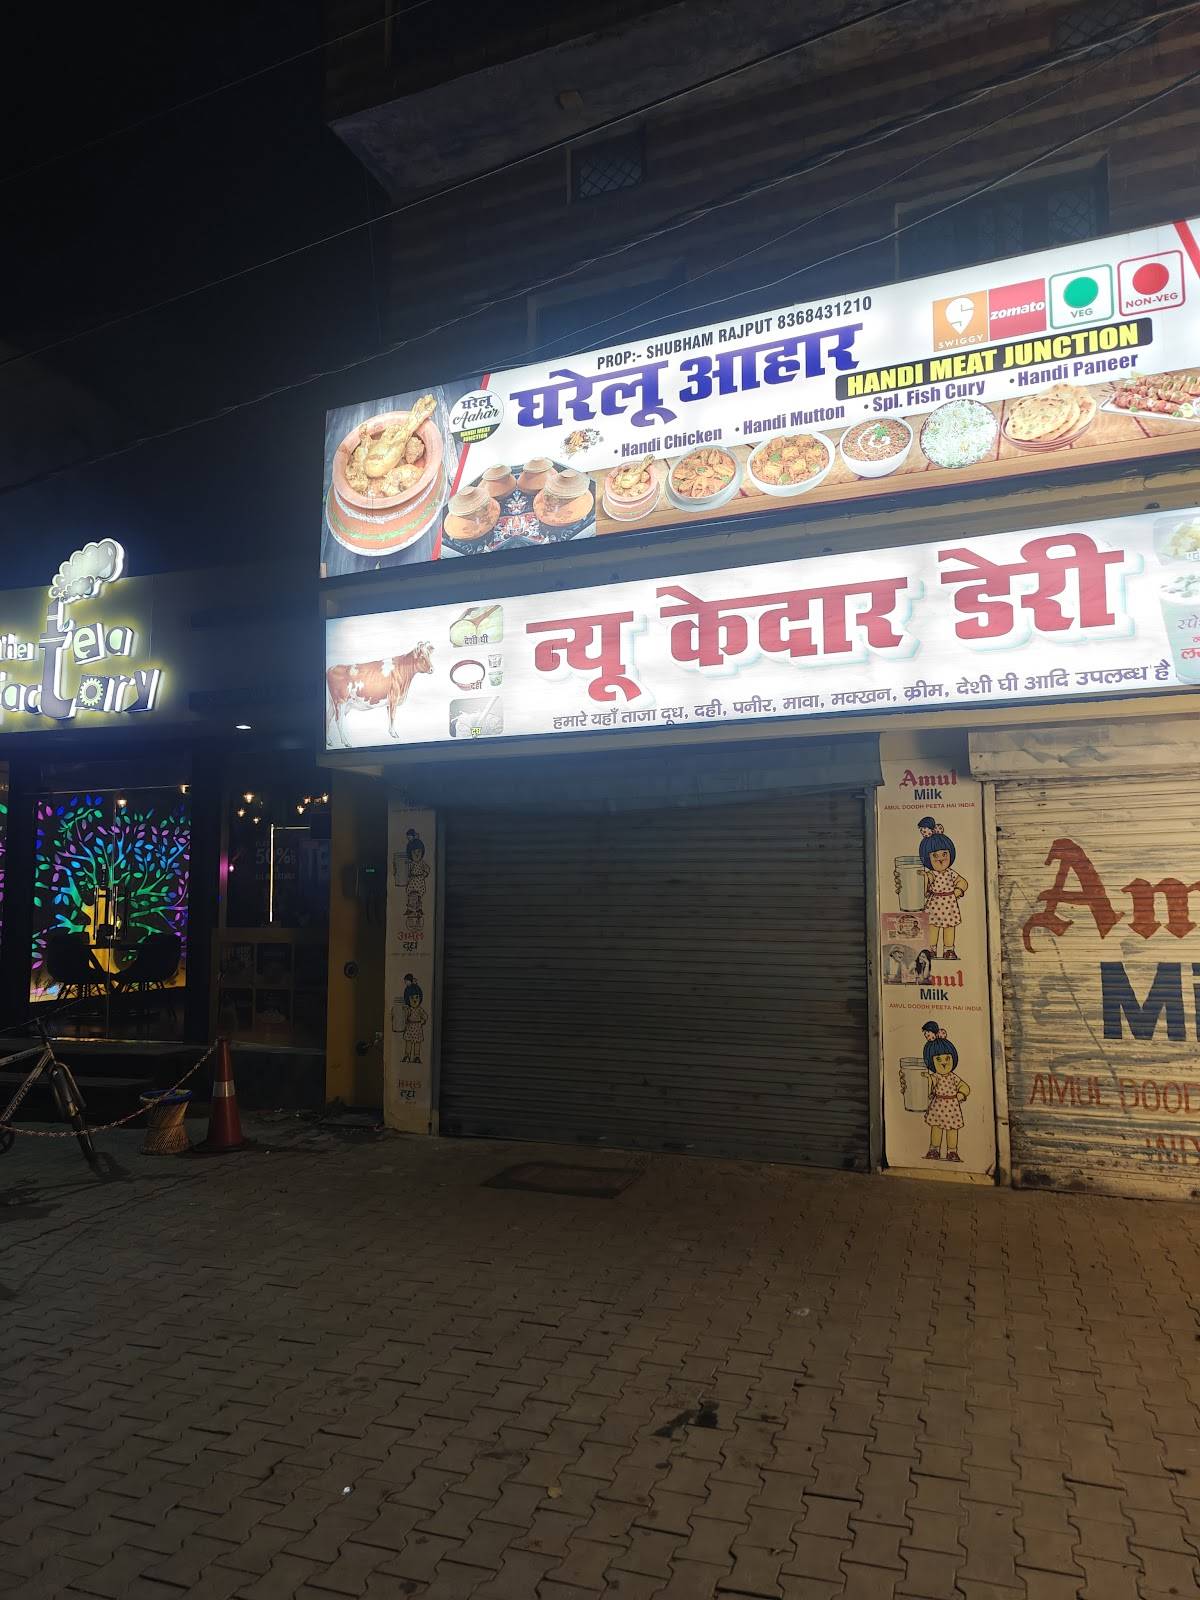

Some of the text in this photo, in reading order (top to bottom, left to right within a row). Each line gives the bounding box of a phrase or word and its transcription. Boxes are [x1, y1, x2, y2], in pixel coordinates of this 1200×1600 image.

[990, 300, 1046, 322] zomato
[1070, 307, 1094, 320] VEG
[1125, 292, 1179, 309] NON-VEG
[597, 295, 873, 370] PROP:- SHUBHAM RAJPUT 8368431210
[938, 334, 985, 350] SWIGGY
[509, 322, 864, 429] घरेलू आहार
[846, 322, 1139, 398] HANDI MEAT JUNCTION
[1018, 352, 1139, 387] Handi Paneer
[872, 379, 986, 413] Spl. Fish Cury
[453, 406, 500, 430] Aahar
[743, 404, 846, 436] Handi Mutton
[621, 426, 722, 458] Handi Chicken
[526, 532, 1125, 702] न्यू केदार डेरी
[553, 713, 587, 730] हमारे
[621, 708, 657, 724] ताजा
[694, 698, 728, 719] दही,
[733, 694, 777, 714] पनीर,
[904, 679, 950, 702] क्रीम,
[957, 671, 992, 695] देशी
[999, 672, 1019, 692] घी
[1025, 668, 1070, 690] आदि
[1154, 658, 1172, 681] है
[898, 768, 959, 790] Amul
[913, 788, 943, 801] Milk
[902, 803, 924, 811] DOODH
[926, 802, 945, 810] PEETA
[1022, 838, 1200, 954] Am
[919, 988, 949, 1001] Milk
